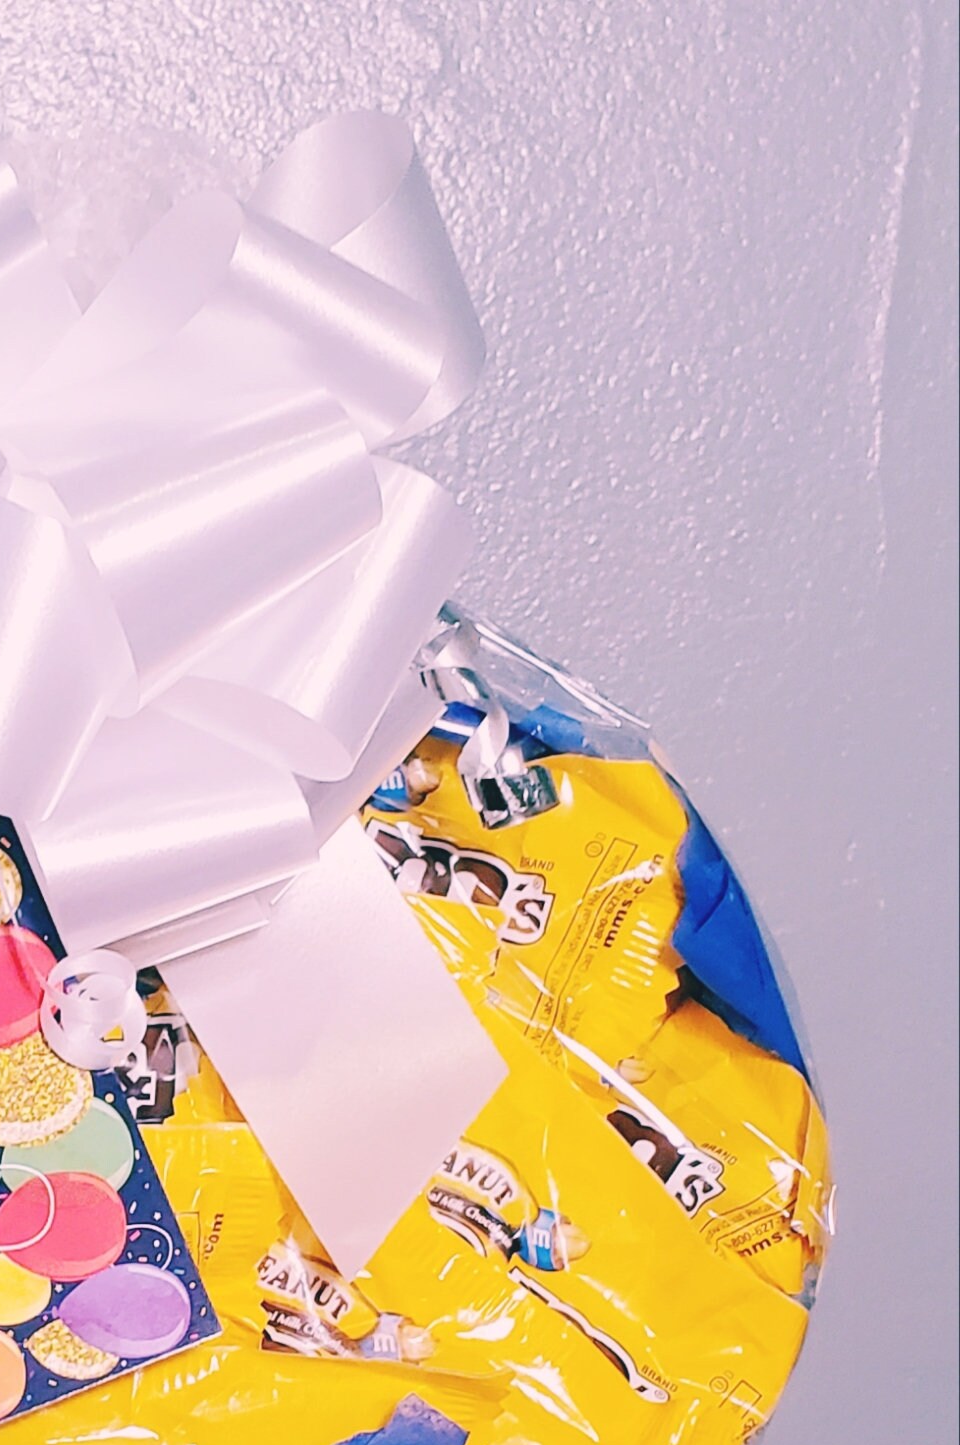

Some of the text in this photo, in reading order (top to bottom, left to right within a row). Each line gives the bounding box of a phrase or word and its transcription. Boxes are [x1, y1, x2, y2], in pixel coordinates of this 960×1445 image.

[519, 856, 555, 872] BRAND
[700, 1141, 738, 1166] BRAND
[442, 1150, 514, 1205] ANUT
[257, 1255, 349, 1320] EANUT
[640, 1364, 679, 1394] BRAND
